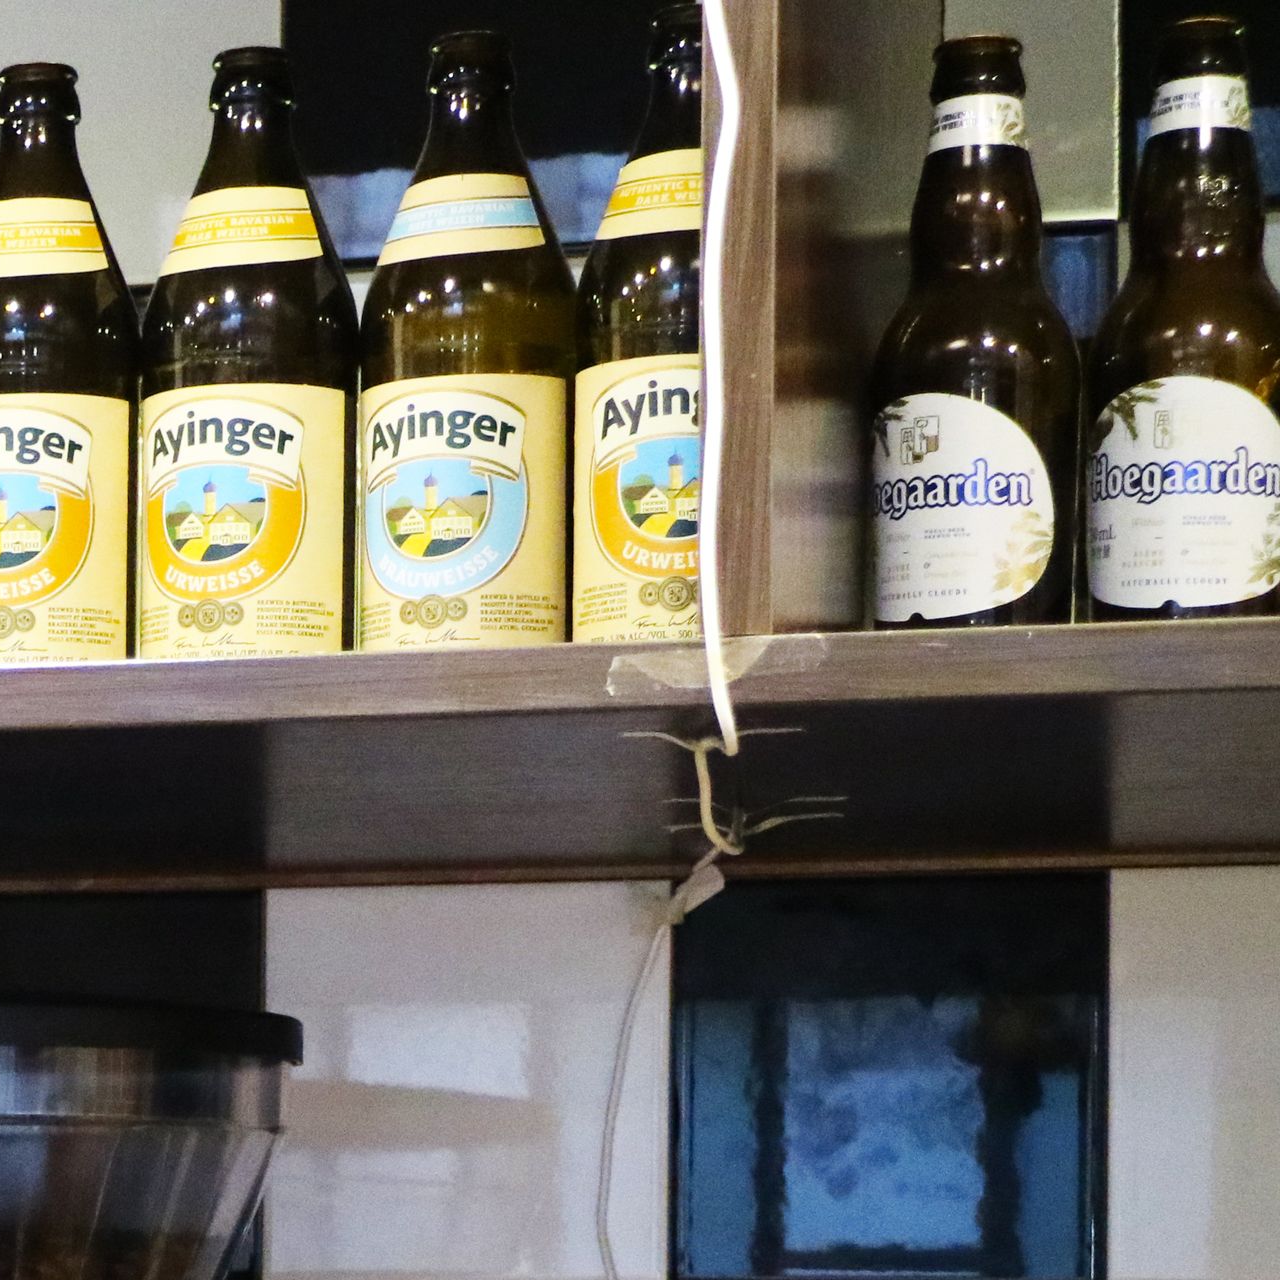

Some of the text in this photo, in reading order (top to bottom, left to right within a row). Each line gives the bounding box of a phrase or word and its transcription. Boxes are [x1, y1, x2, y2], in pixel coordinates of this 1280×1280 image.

[152, 410, 294, 468] Ayinger
[370, 403, 517, 462] Ayinger
[601, 379, 701, 441] Ayin
[873, 457, 1034, 521] oegaarden
[1090, 446, 1280, 505] Hoegaarden
[165, 560, 266, 593] URWEISSE
[621, 539, 701, 571] URWEI
